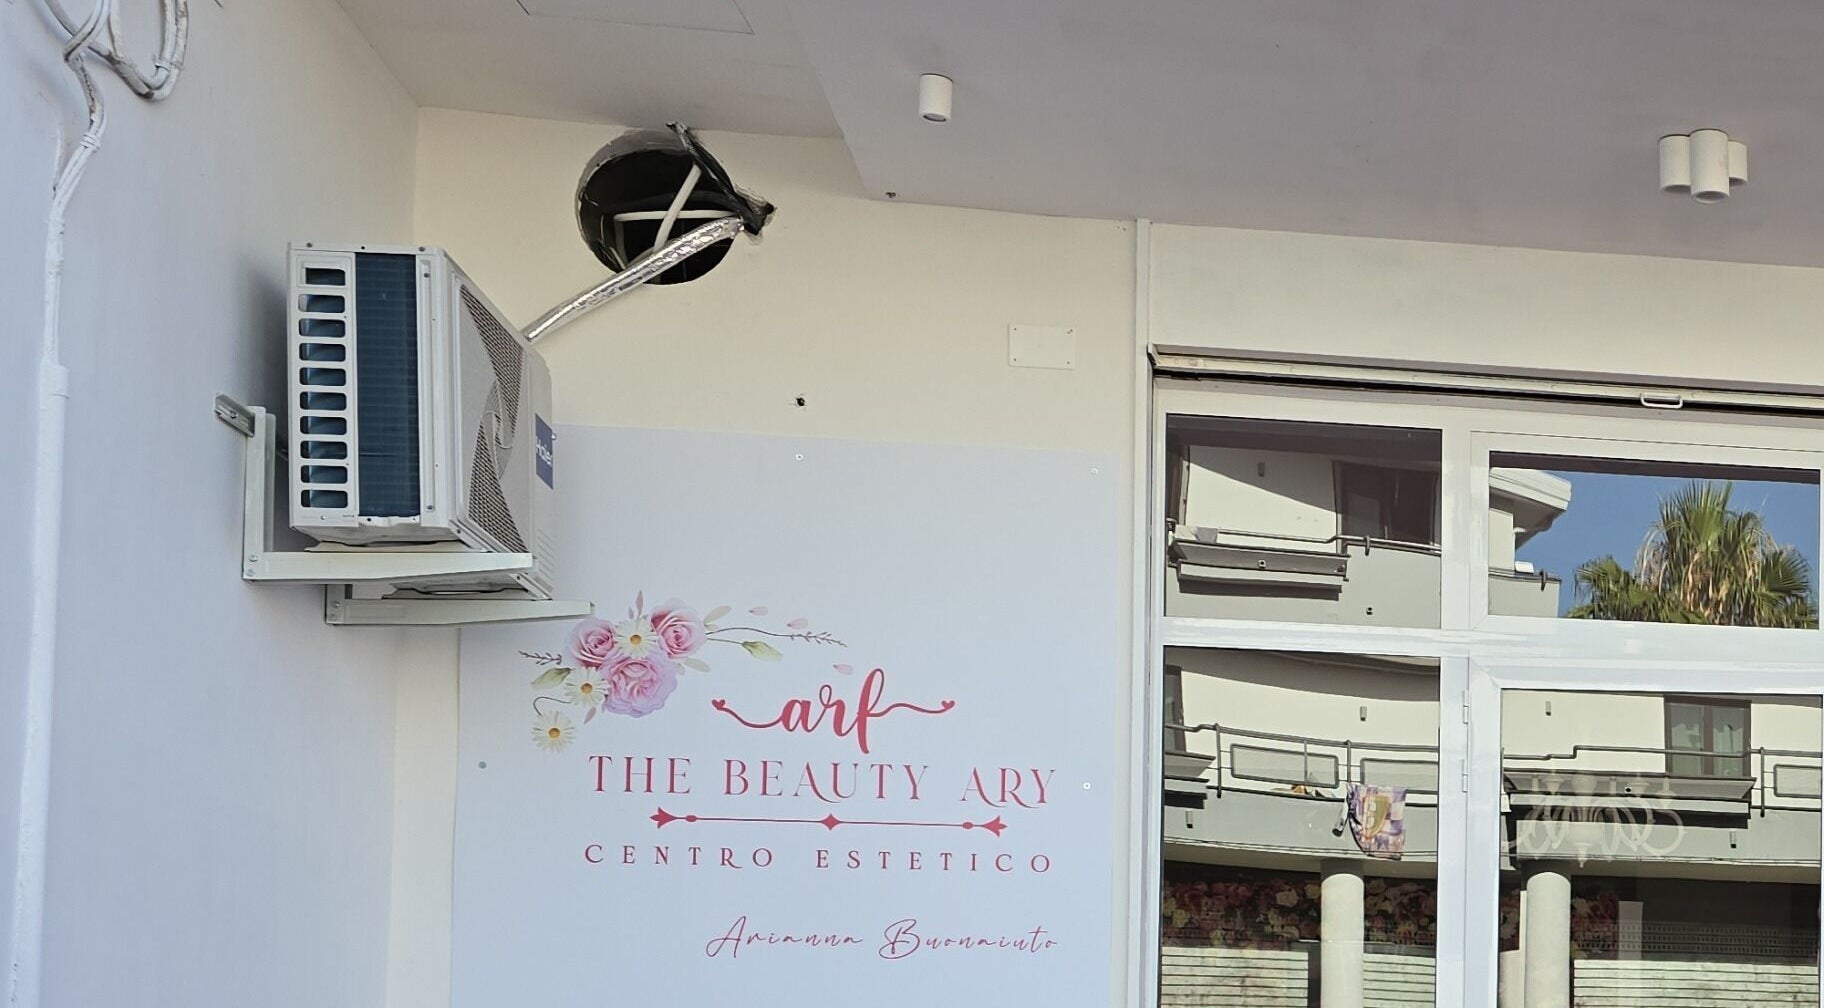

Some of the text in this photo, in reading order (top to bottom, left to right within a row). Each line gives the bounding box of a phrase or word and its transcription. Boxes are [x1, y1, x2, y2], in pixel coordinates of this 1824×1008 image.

[588, 754, 1056, 809] THE BEAUTY ARY
[583, 844, 1053, 874] CENTRO ESTETICO
[706, 915, 1058, 961] Arianna Buonaiuto
